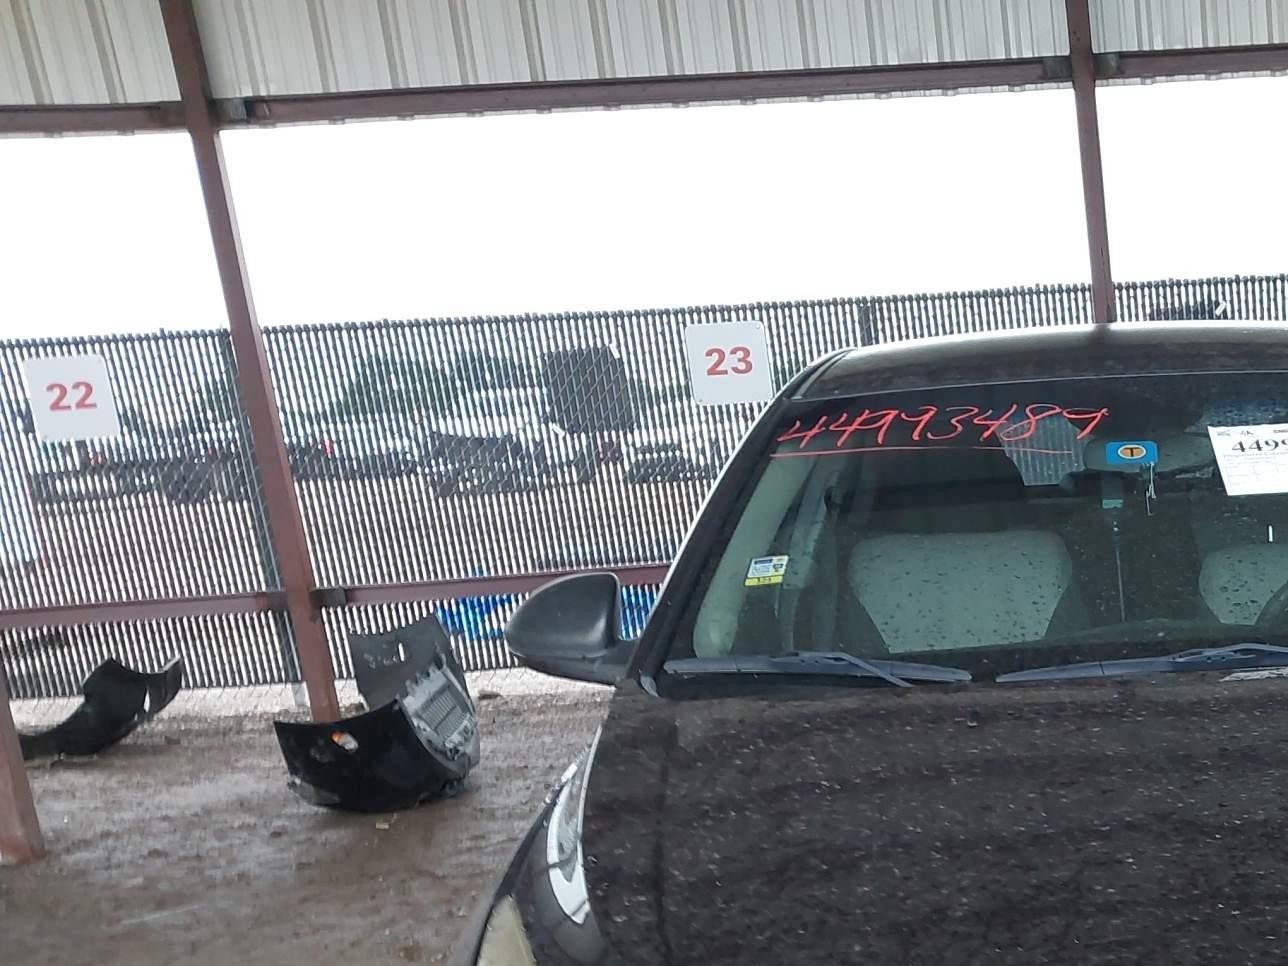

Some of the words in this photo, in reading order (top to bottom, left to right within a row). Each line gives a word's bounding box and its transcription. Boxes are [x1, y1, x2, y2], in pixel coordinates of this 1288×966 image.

[705, 346, 753, 376] 23
[46, 381, 97, 411] 22
[776, 403, 1110, 449] 44993489
